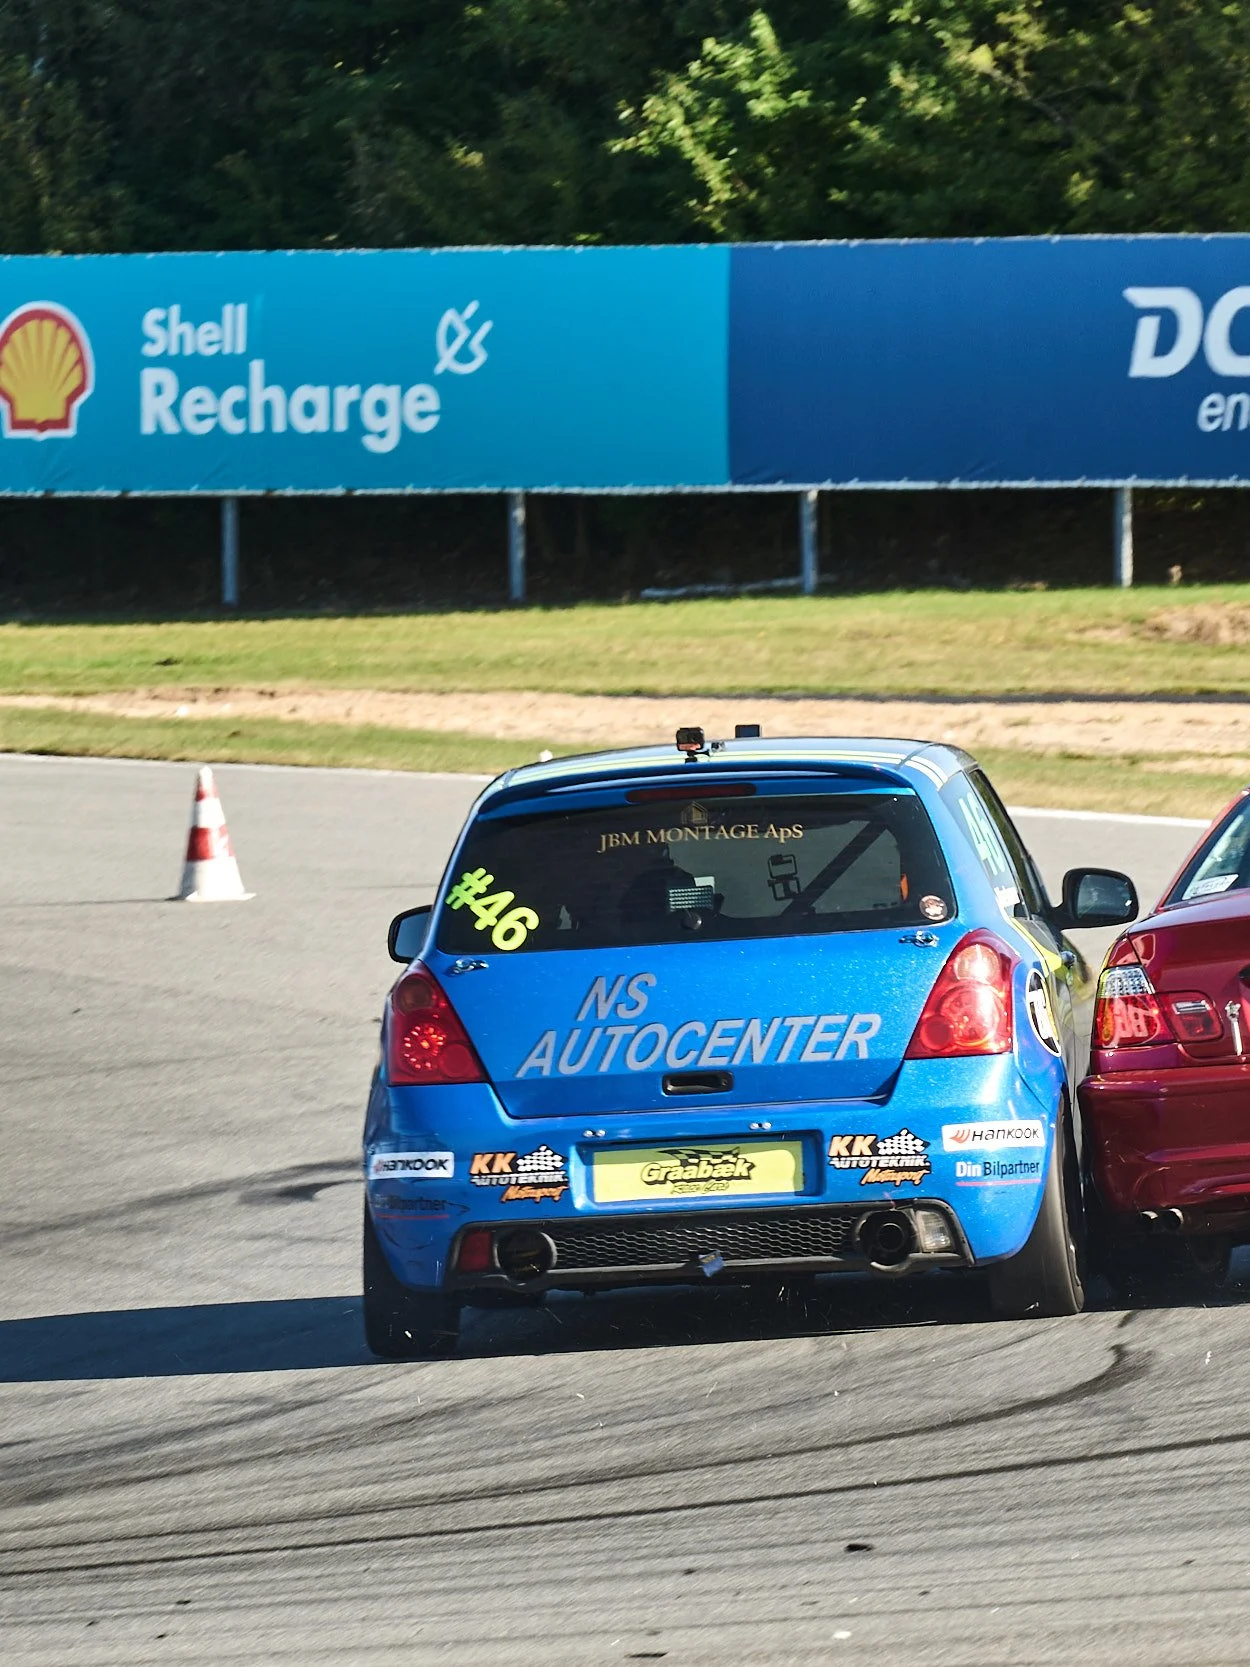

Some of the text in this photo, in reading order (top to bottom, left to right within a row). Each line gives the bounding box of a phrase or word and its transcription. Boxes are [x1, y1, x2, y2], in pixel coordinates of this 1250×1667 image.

[141, 303, 248, 357] Shell
[140, 358, 442, 454] Recharge
[597, 823, 804, 853] JBM MONTAGE ApS
[445, 867, 540, 951] #46
[576, 972, 657, 1022] NS
[515, 1013, 882, 1078] AUTOCENTER
[470, 1152, 517, 1174] KK
[828, 1134, 877, 1157] KK
[641, 1159, 755, 1186] Graabæk
